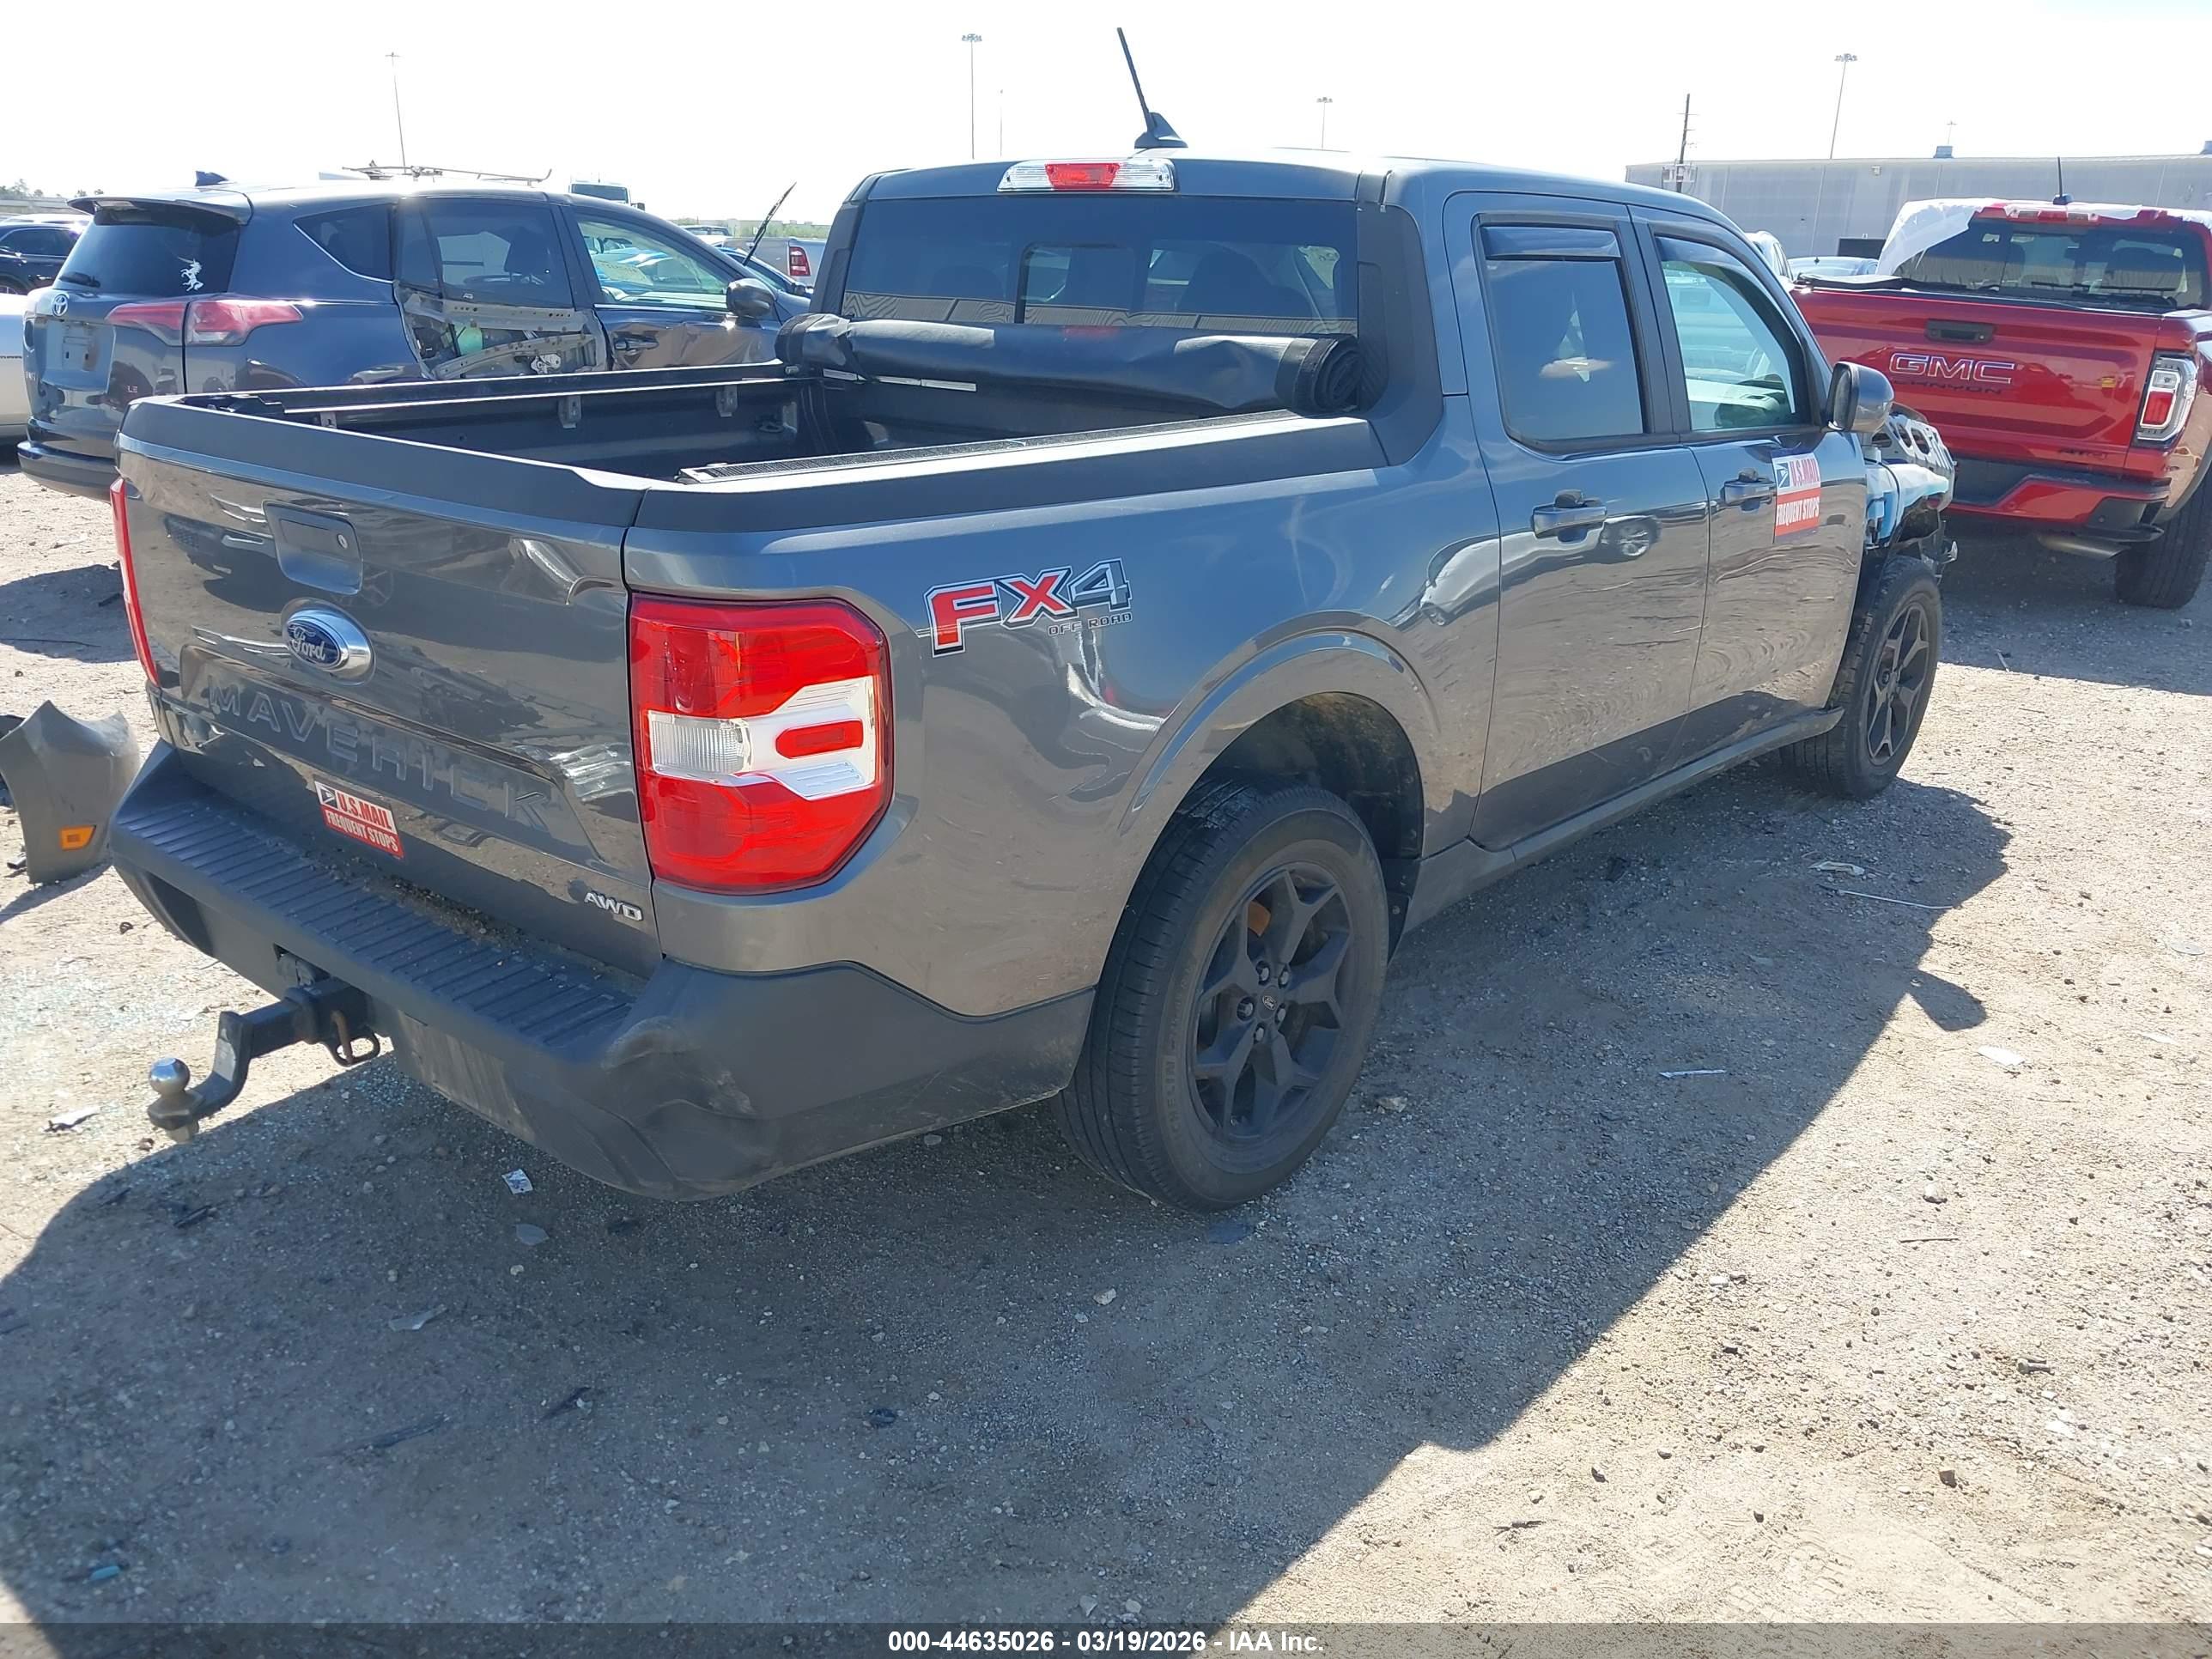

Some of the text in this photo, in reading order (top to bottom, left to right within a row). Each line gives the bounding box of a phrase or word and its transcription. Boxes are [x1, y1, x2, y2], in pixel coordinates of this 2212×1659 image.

[1889, 352, 2015, 384] GMC
[924, 558, 1133, 658] FX4
[1048, 611, 1133, 637] OFF ROAD
[289, 626, 327, 660] Ford
[207, 674, 552, 833] MAVERICK
[325, 810, 398, 852] FREQUENT STOPS
[584, 890, 643, 921] AWD
